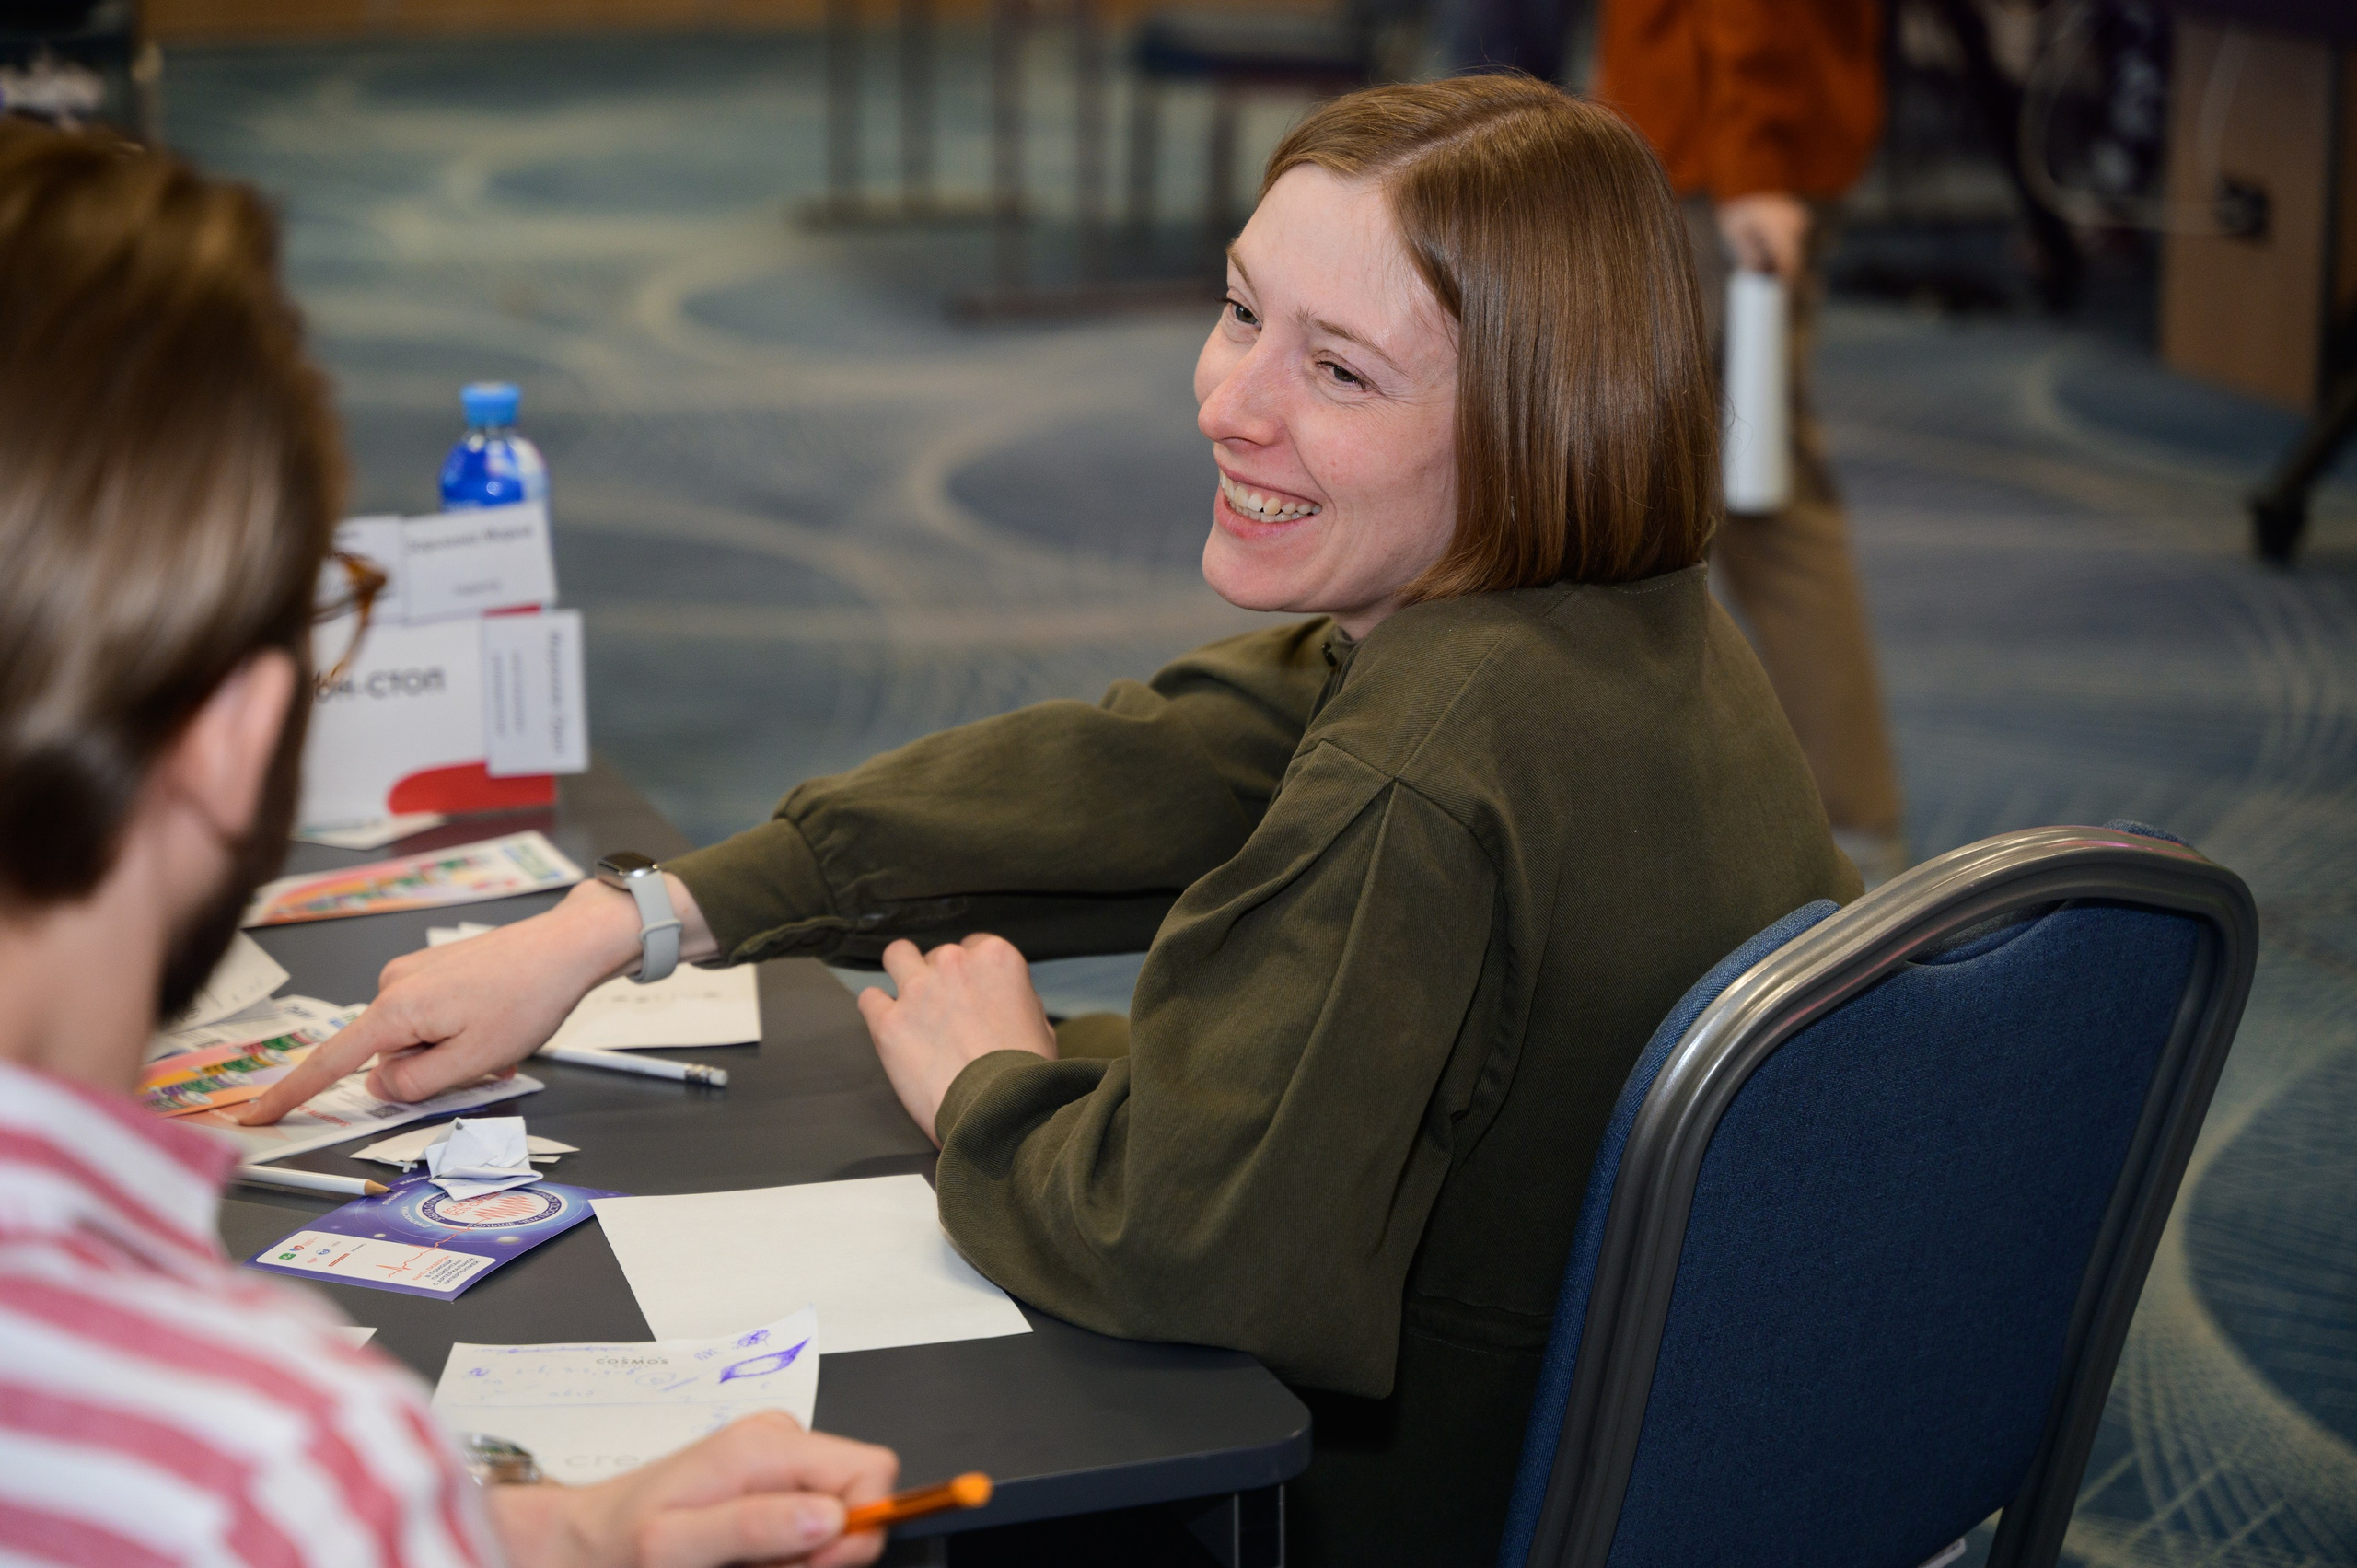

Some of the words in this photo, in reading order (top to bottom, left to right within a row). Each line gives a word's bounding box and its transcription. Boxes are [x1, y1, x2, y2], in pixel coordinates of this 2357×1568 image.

[424, 1208, 445, 1222] ЗАБОТА
[519, 1215, 541, 1225] ЧЕМ
[540, 1202, 561, 1221] ПРОСТО
[425, 1255, 451, 1272] ЛИДЕРОМ
[429, 1260, 453, 1275] ПОМОЩИ
[431, 1260, 462, 1281] ПАЦИЕНТАМ
[437, 1257, 475, 1283] АРТЕРИАЛЬНОЙ
[443, 1260, 480, 1285] ГИПЕРТЕНЗИЕЙ
[564, 1454, 643, 1470] cre
